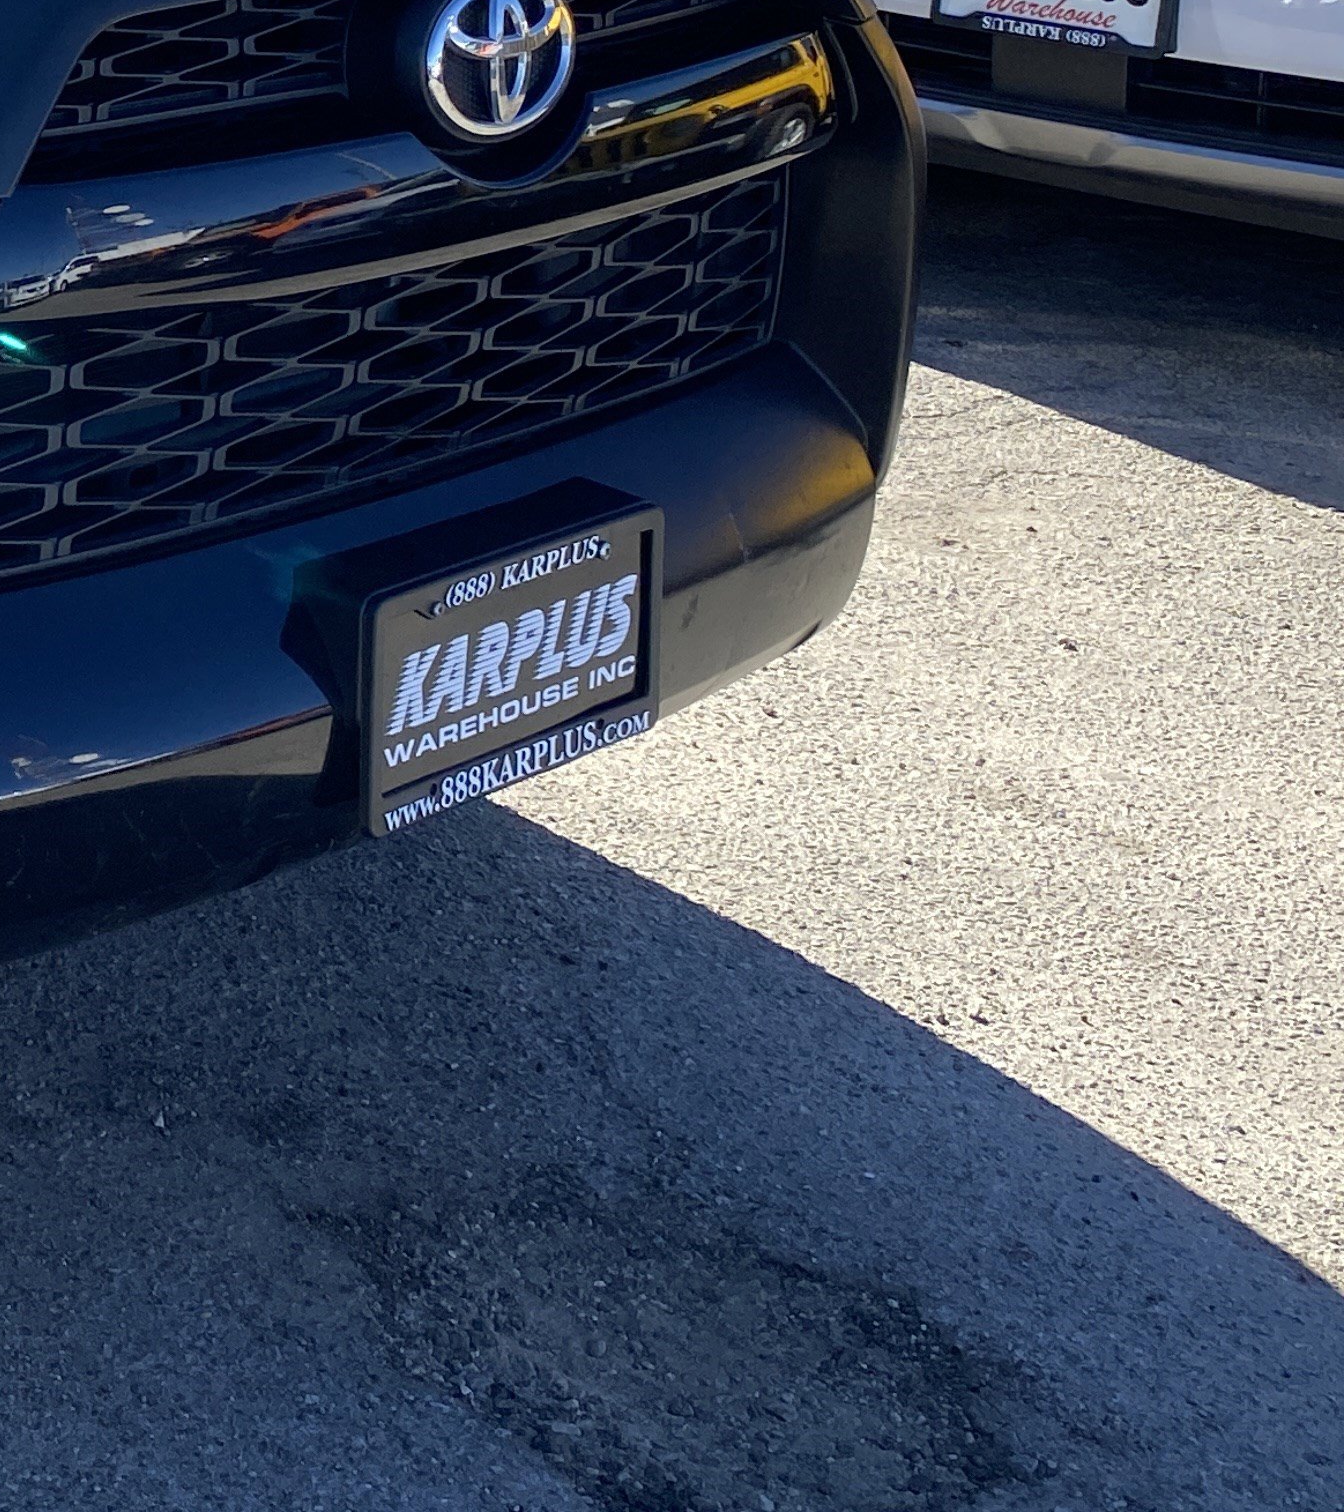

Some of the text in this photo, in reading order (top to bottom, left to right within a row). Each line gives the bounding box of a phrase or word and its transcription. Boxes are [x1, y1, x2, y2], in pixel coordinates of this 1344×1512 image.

[981, 15, 1107, 48] (888) KARPLUS
[444, 535, 600, 609] (888) KARPLUS
[384, 573, 639, 736] KARPLUS
[383, 654, 637, 768] WAREHOUSE INC
